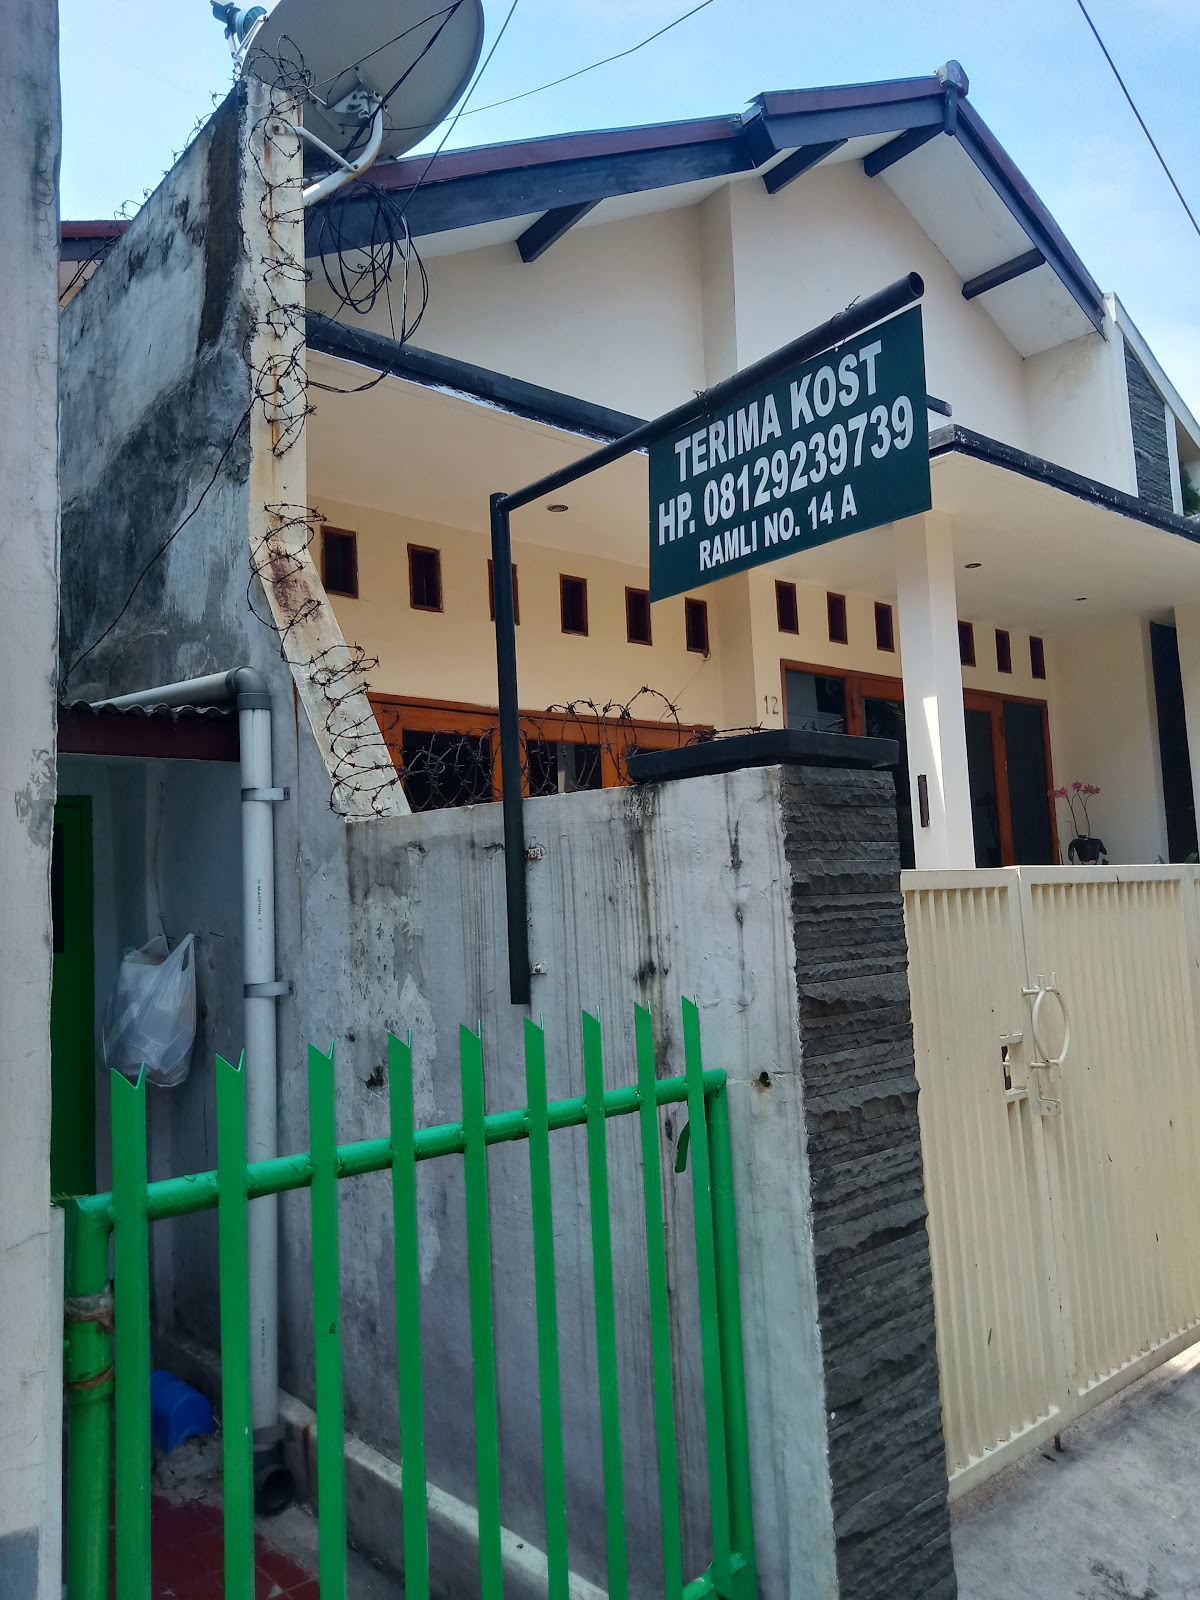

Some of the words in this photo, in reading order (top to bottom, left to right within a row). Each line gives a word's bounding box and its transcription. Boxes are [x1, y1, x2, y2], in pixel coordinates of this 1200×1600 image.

[674, 393, 782, 482] TERIMA
[789, 339, 882, 430] KOST
[657, 491, 696, 546] HP.
[703, 395, 914, 526] 08129239739
[699, 520, 758, 571] RAMLI
[763, 507, 801, 547] NO.
[807, 491, 834, 530] 14
[840, 484, 858, 520] A
[763, 694, 780, 715] 12
